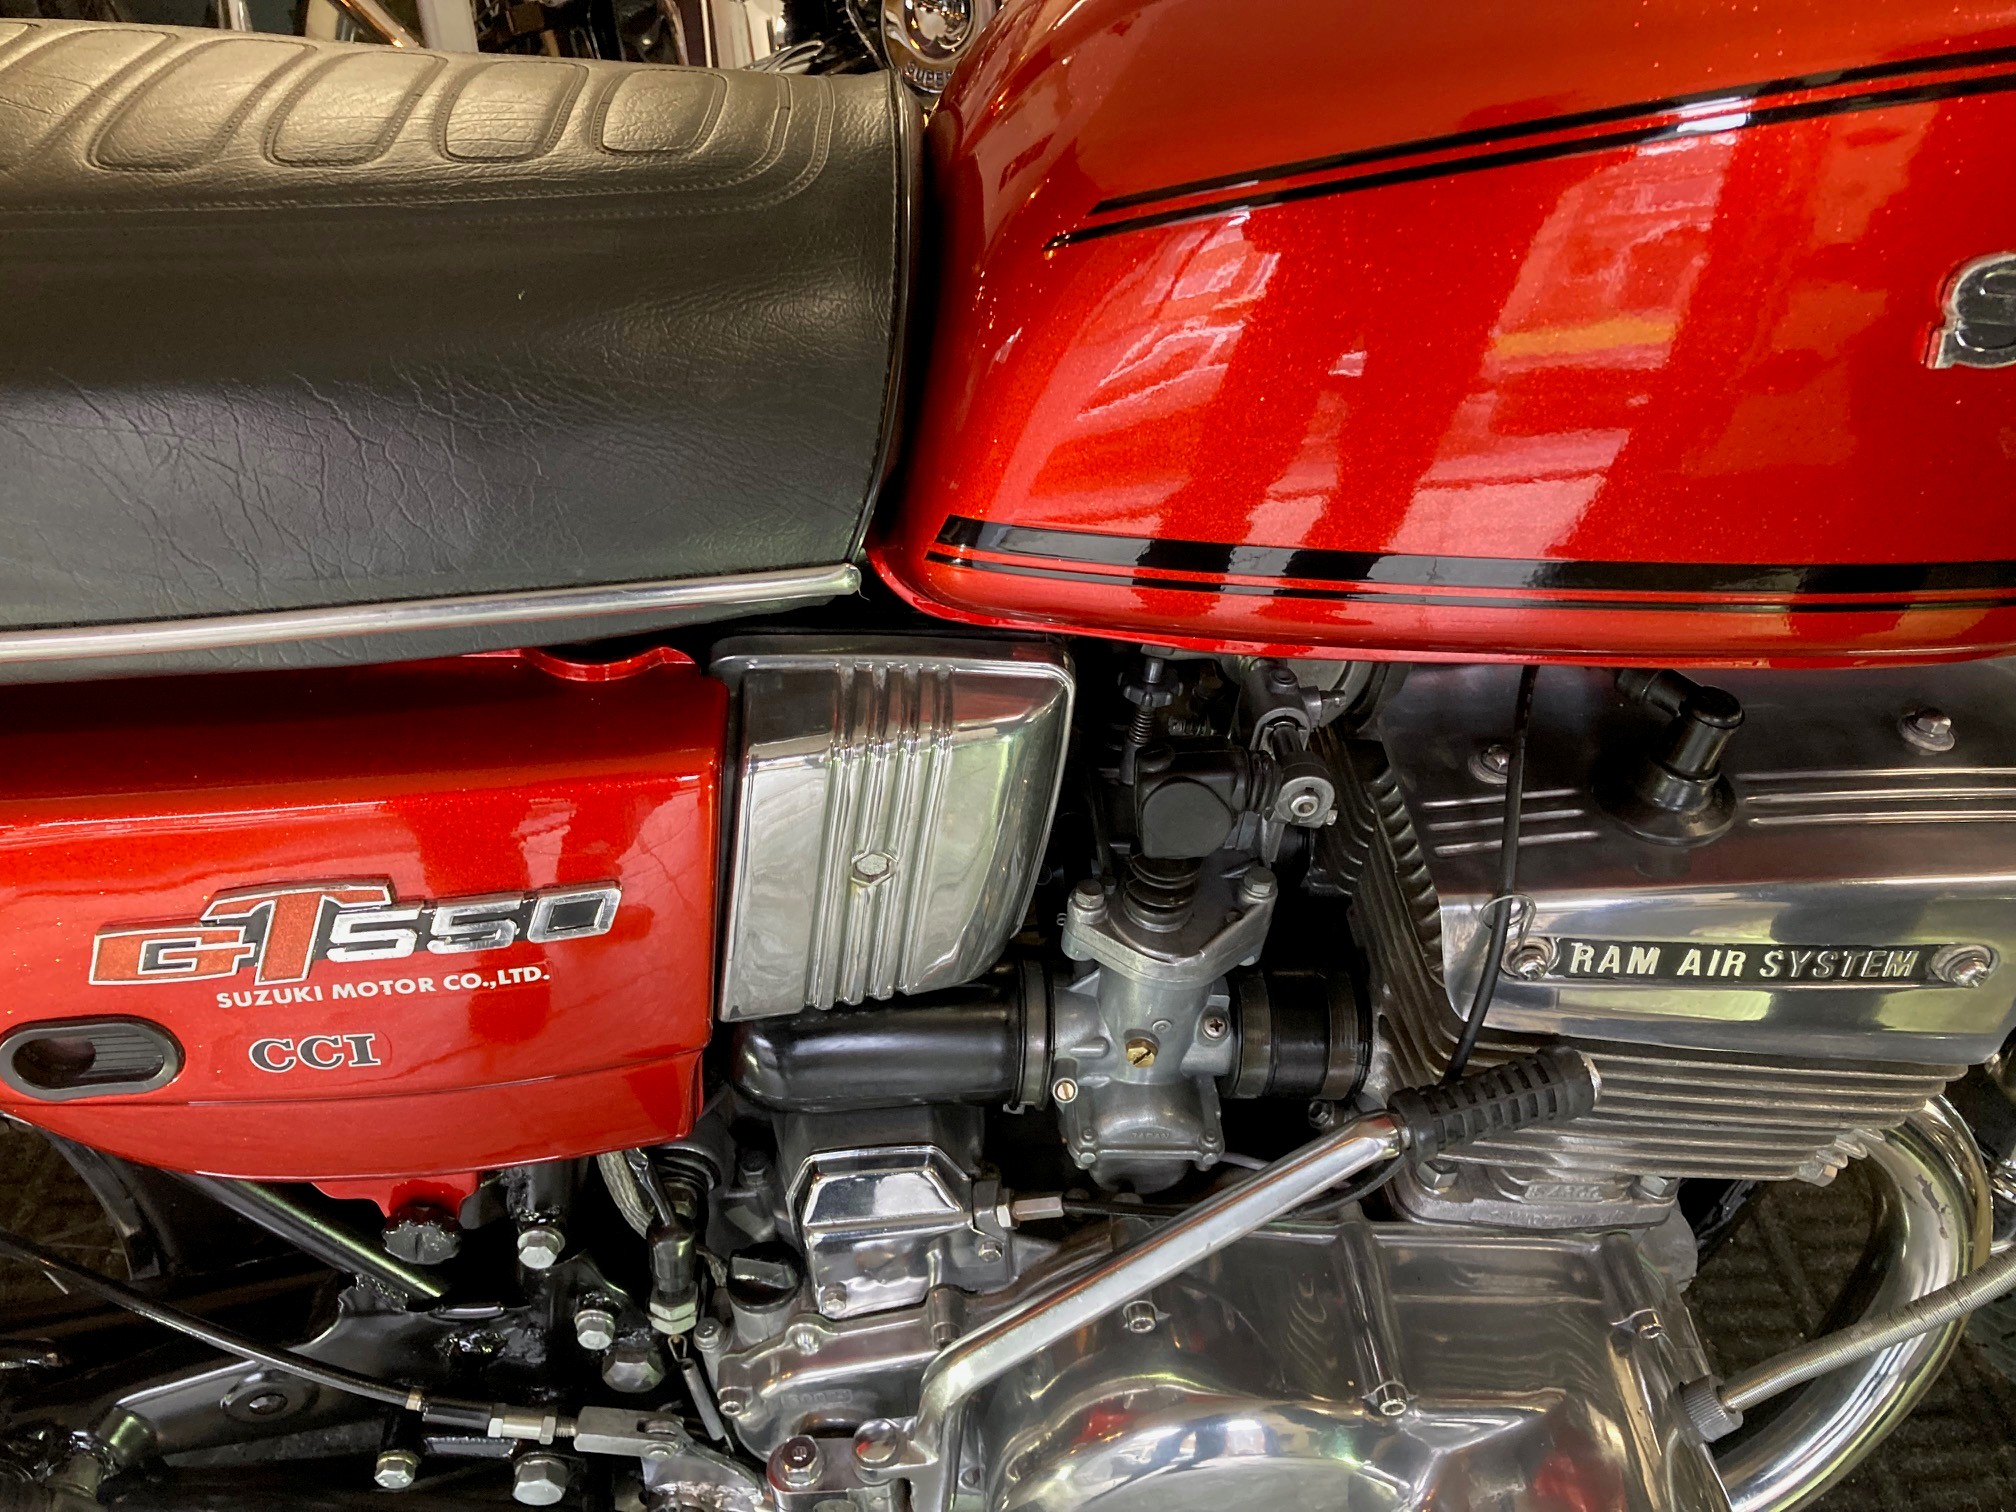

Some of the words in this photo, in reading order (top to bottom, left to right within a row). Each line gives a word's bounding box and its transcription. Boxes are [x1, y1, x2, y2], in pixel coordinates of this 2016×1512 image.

[1569, 942, 1661, 975] RAM
[1676, 948, 1746, 977] AIR
[1759, 949, 1920, 978] SYSTEM
[216, 985, 323, 1009] SUZUKI
[332, 977, 437, 999] MOTOR
[248, 1033, 382, 1073] CCI
